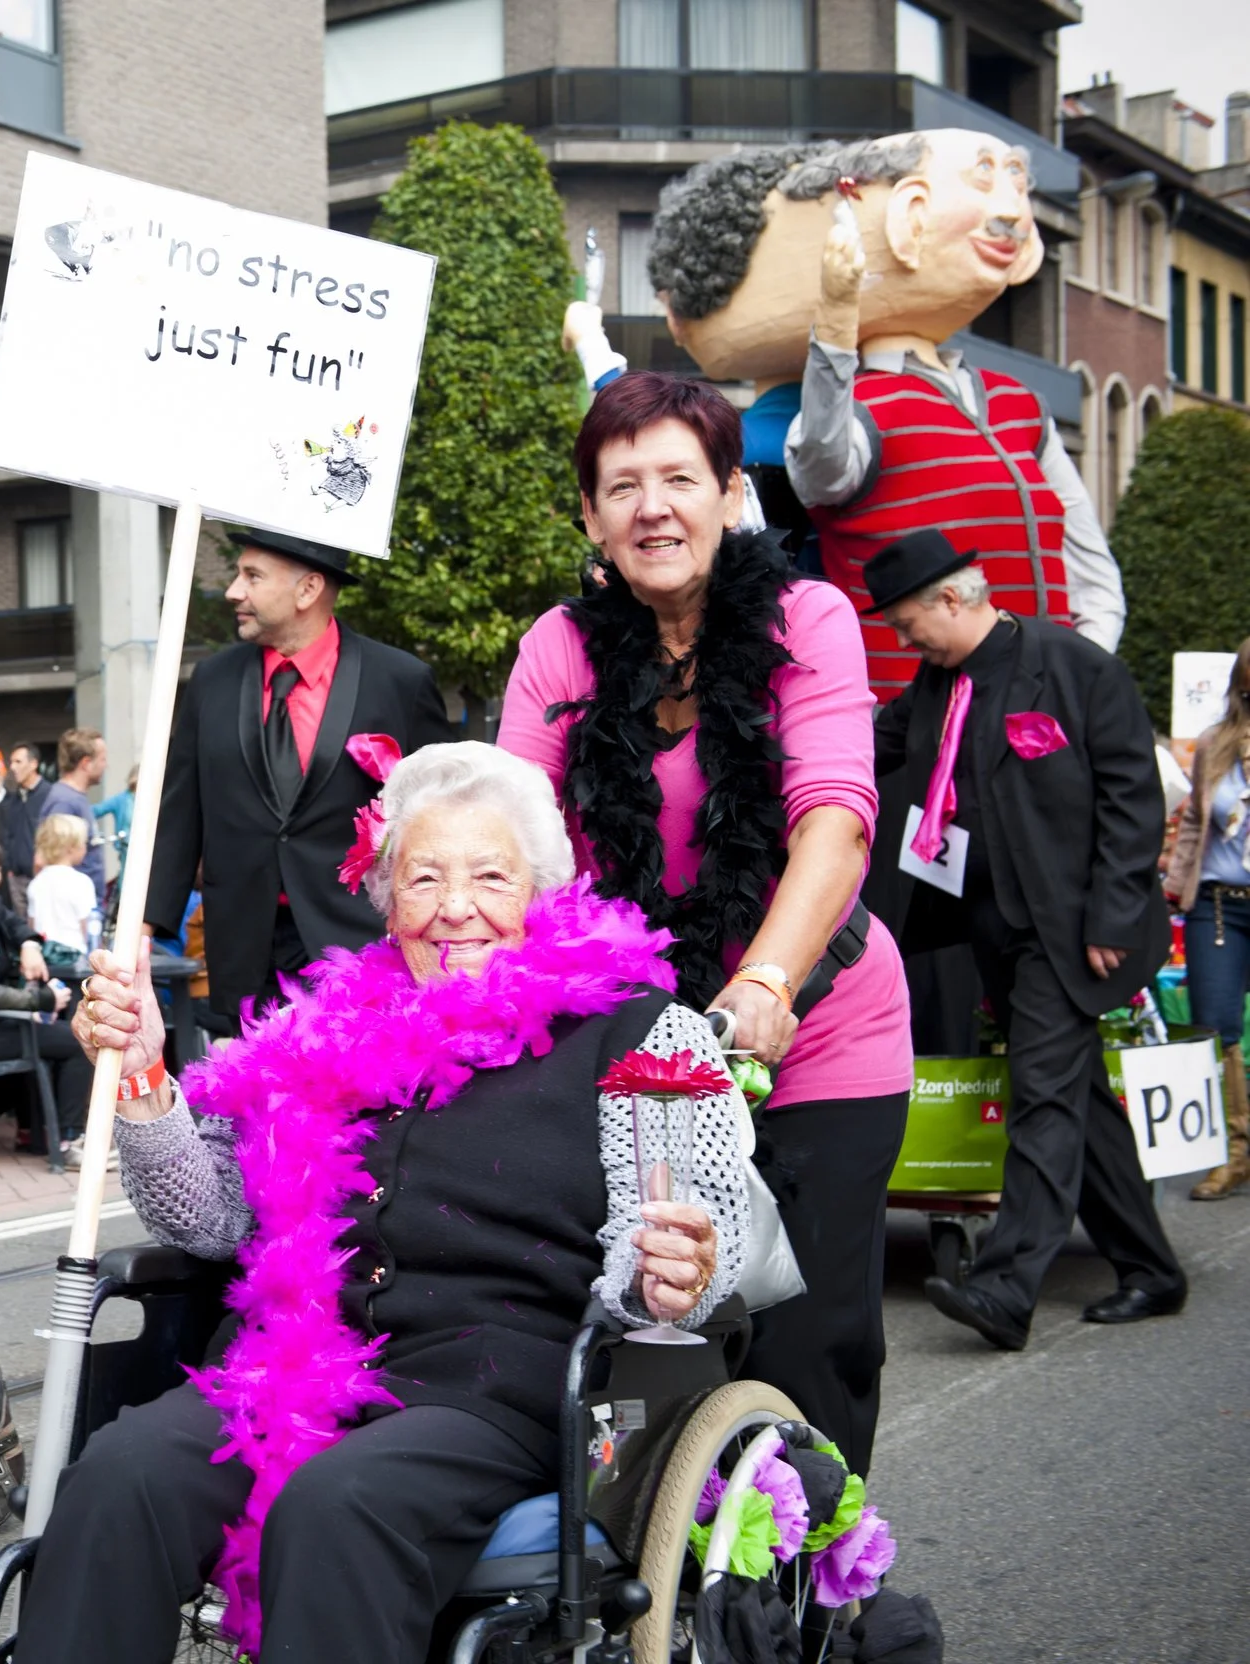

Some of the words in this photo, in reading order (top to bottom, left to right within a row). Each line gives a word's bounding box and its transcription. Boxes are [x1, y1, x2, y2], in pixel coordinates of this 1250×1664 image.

[238, 254, 390, 320] stress
[144, 304, 248, 366] just
[266, 331, 364, 391] fun"
[916, 1077, 1002, 1097] Zorgbedrijf
[985, 1105, 999, 1120] A
[1141, 1077, 1219, 1149] Pol
